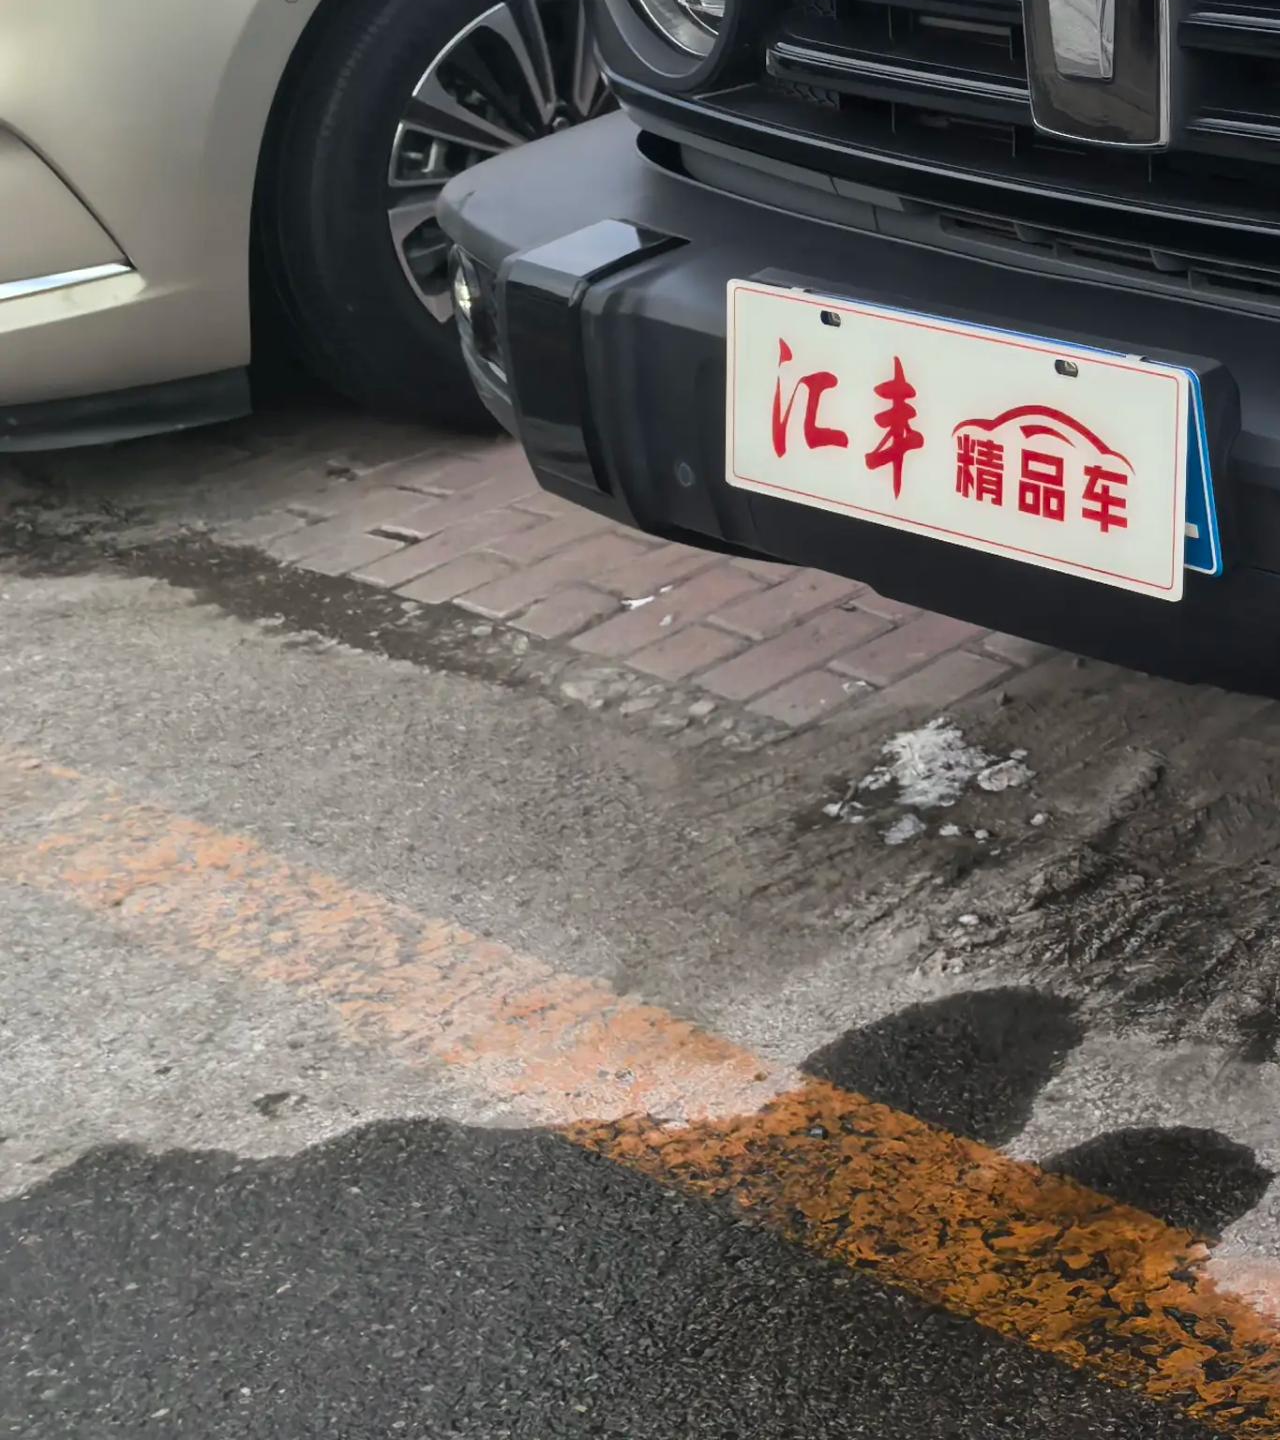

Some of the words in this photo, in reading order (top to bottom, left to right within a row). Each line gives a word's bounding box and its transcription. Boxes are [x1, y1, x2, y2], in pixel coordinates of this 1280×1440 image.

[771, 336, 925, 500] 汇丰
[954, 433, 1129, 534] 精品车
